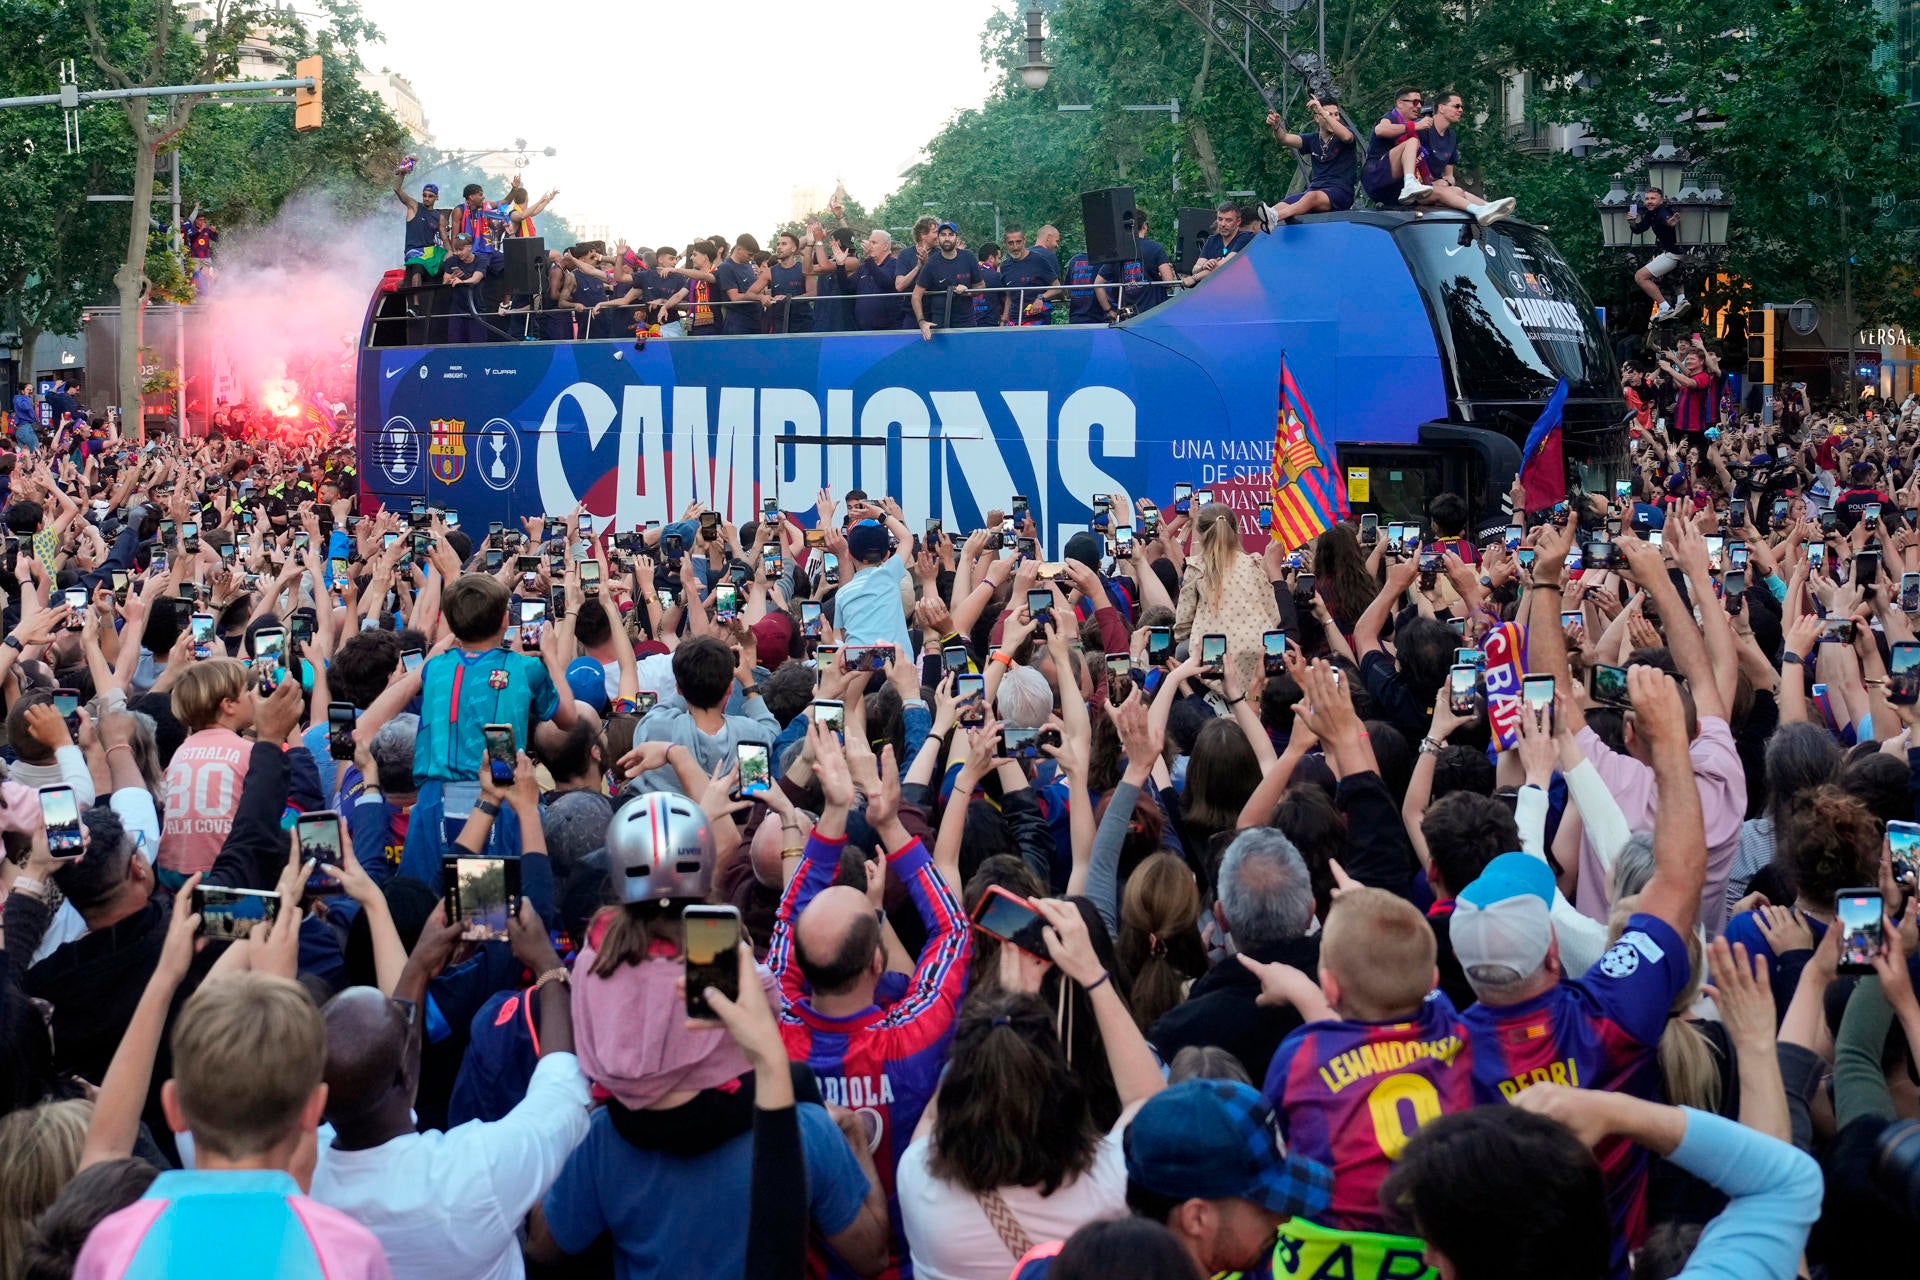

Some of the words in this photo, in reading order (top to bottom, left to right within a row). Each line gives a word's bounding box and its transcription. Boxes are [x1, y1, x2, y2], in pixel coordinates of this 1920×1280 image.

[1172, 440, 1215, 459] UNA
[1221, 441, 1275, 461] MANE
[537, 381, 1137, 562] CAMPIONS
[1203, 464, 1228, 484] DE
[1233, 465, 1274, 485] SER
[1497, 1057, 1579, 1105] PEDRI
